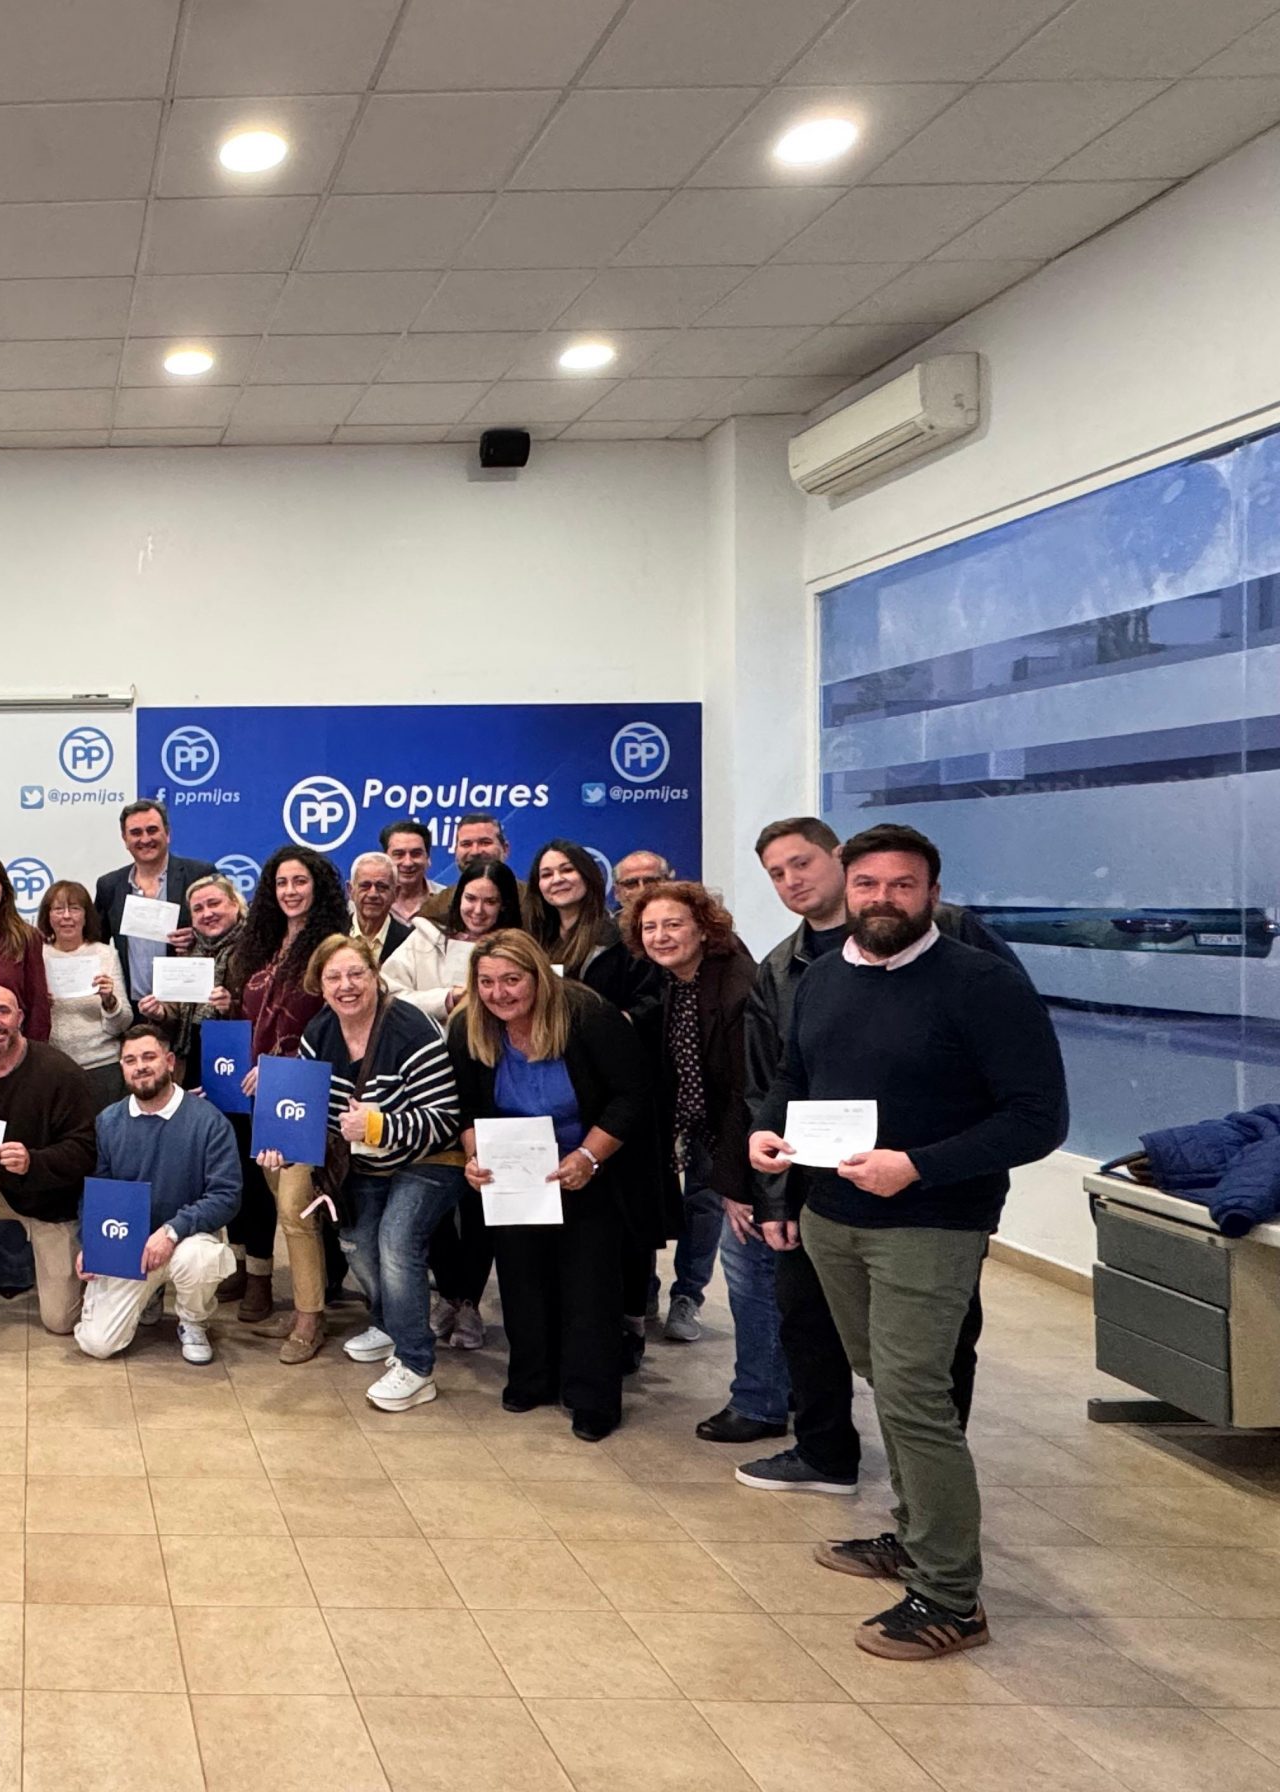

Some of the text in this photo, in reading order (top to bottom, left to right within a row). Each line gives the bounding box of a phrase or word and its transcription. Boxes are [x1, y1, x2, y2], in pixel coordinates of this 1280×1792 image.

[72, 745, 104, 770] PP
[175, 746, 209, 771] PP
[624, 742, 659, 768] PP
[48, 788, 125, 805] @ppmijas
[175, 788, 241, 806] ppmijas
[362, 777, 549, 815] Populares
[609, 786, 689, 803] @ppmijas
[300, 801, 344, 834] PP
